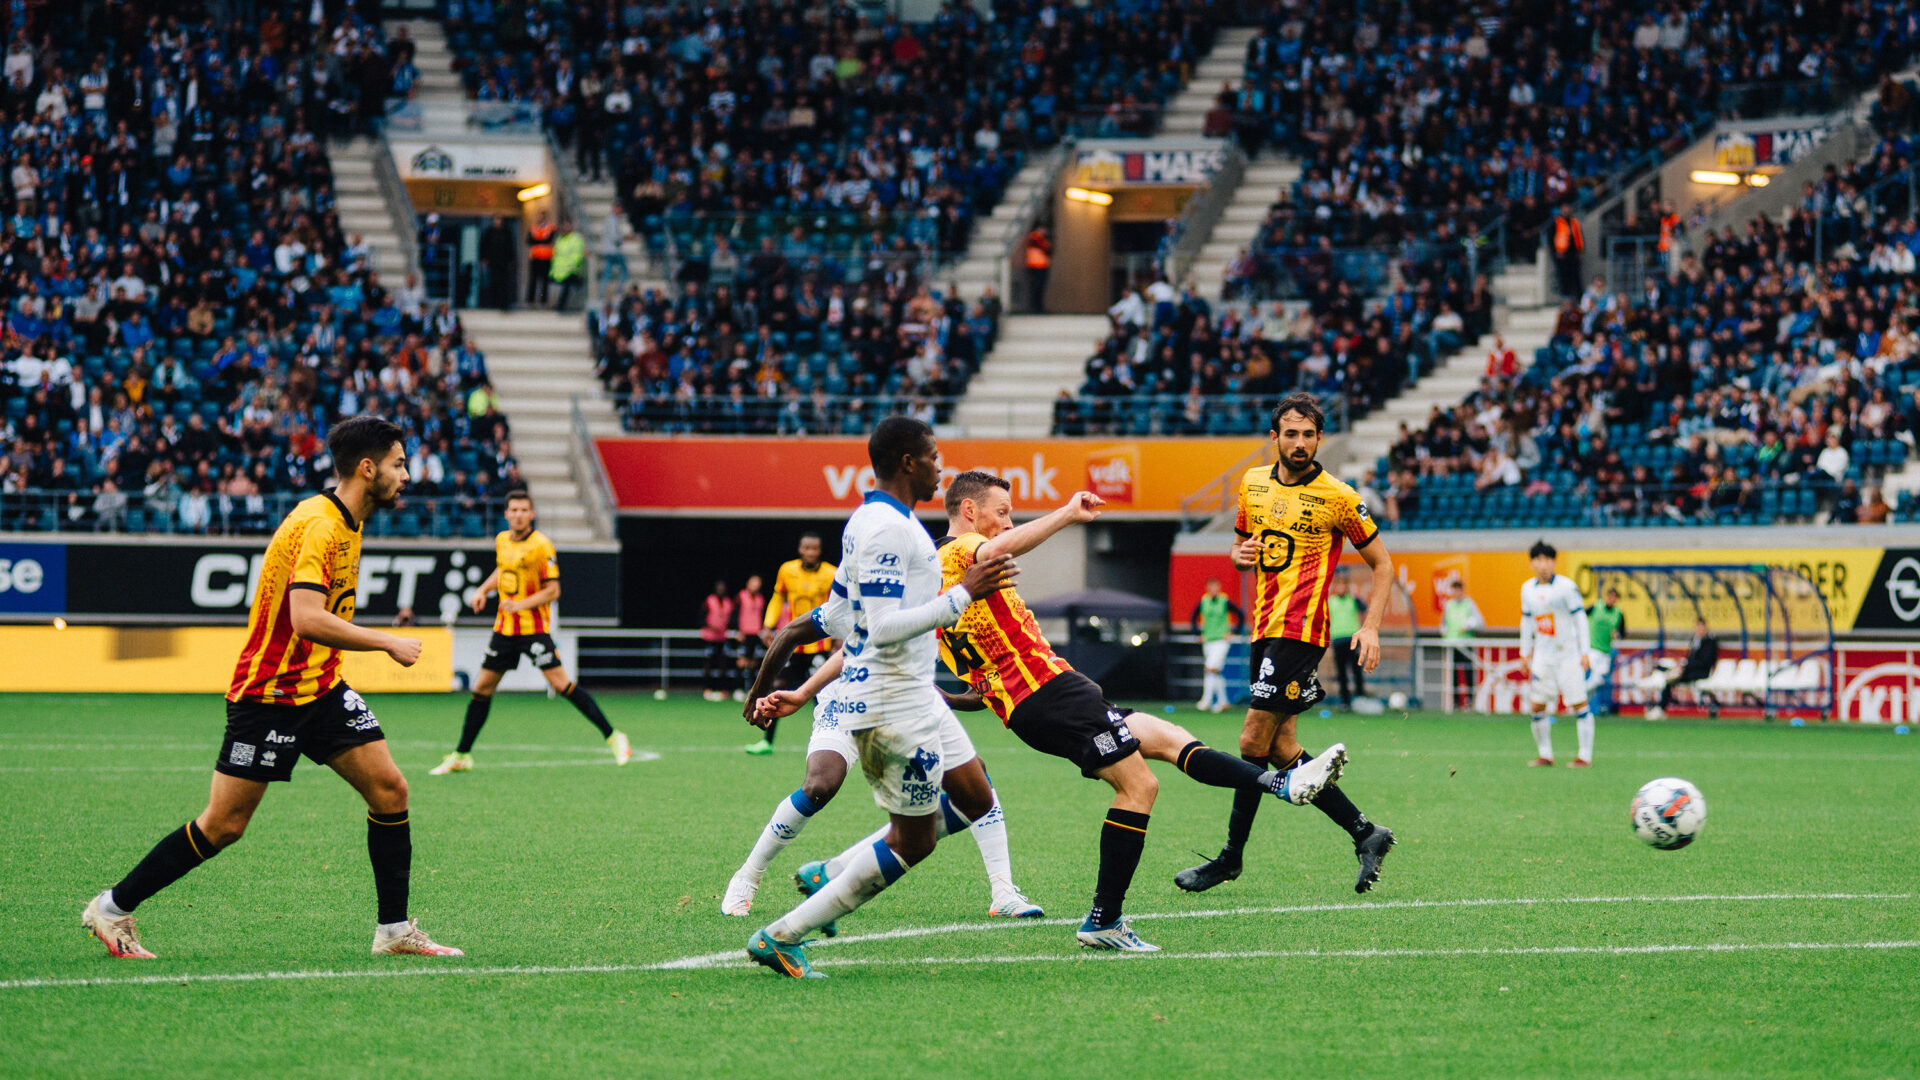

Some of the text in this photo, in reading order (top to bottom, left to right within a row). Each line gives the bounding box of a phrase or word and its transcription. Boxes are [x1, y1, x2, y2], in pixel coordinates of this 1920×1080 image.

[1290, 522, 1321, 536] AFAS
[191, 552, 436, 608] CFT
[837, 696, 868, 714] oise
[902, 781, 934, 793] KING
